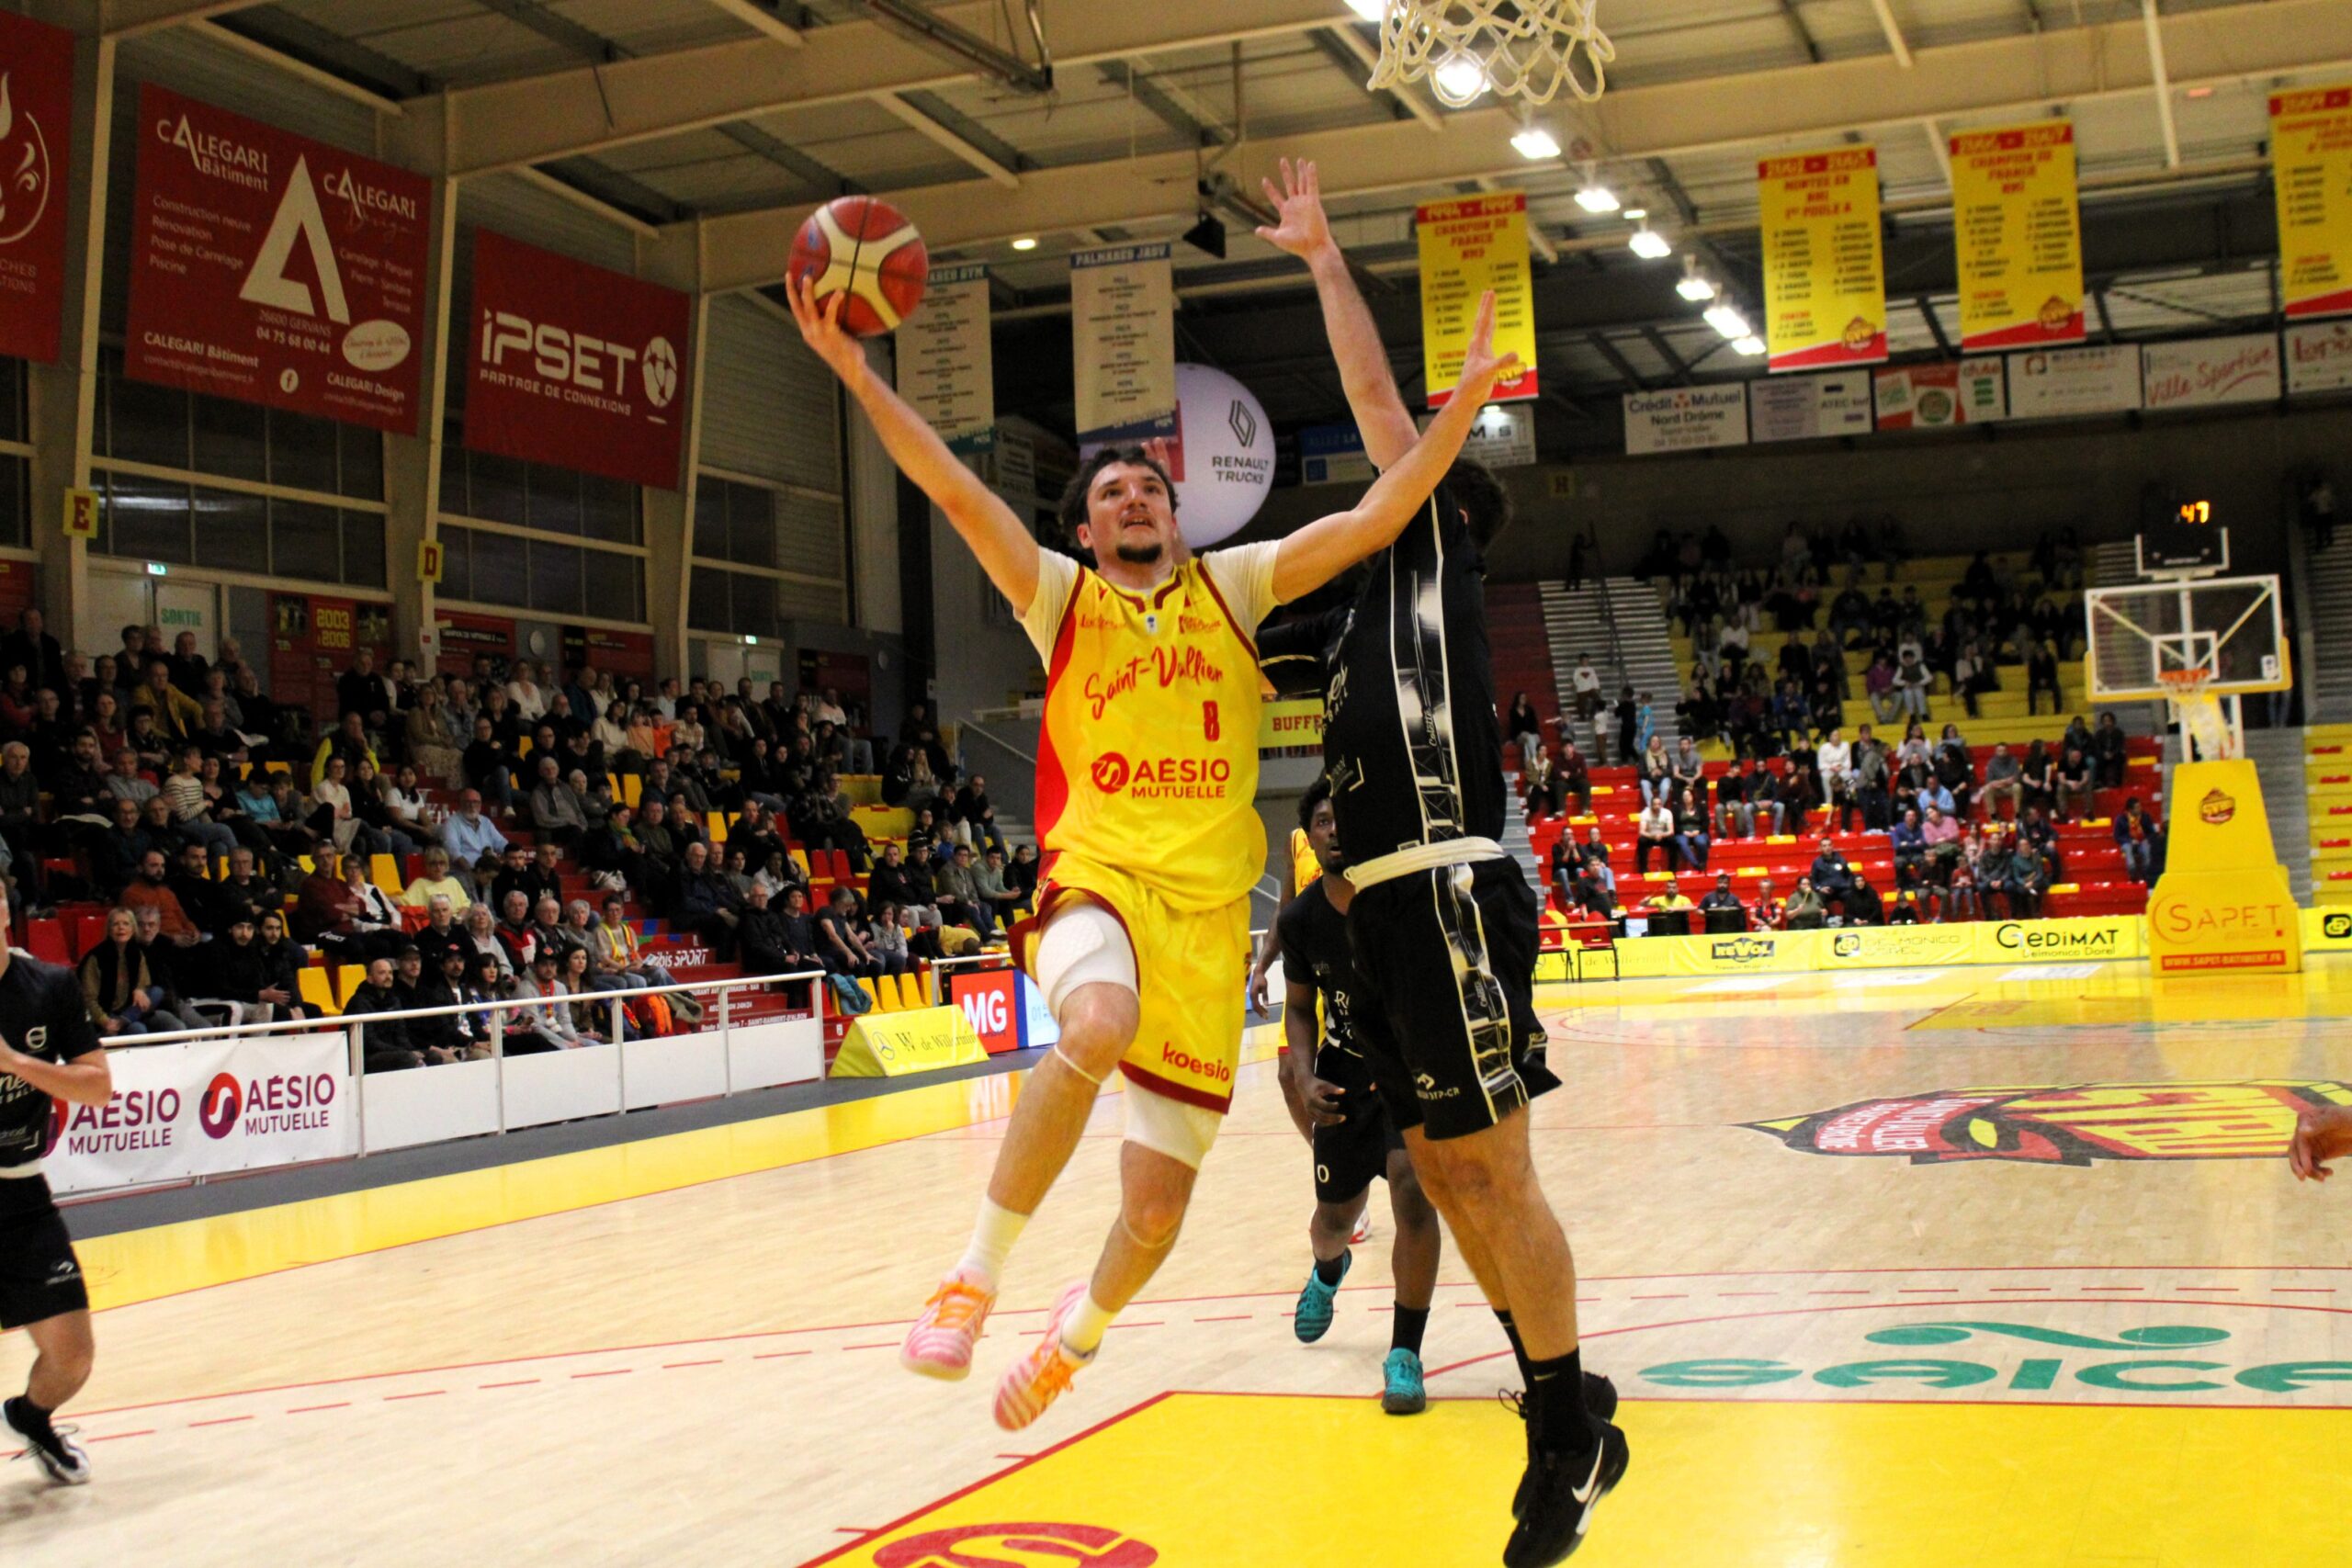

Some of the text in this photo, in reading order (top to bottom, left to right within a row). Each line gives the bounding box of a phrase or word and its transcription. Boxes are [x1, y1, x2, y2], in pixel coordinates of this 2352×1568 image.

[157, 113, 268, 174] CALEGARI
[323, 168, 415, 220] CALEGARI
[256, 325, 270, 340] 04
[274, 329, 286, 344] 75
[144, 332, 259, 368] CALEGARI Bâtiment
[326, 371, 373, 394] CALEGARI
[480, 368, 540, 394] PARTAGE
[545, 387, 560, 399] DE
[1691, 389, 1740, 405] Mutuel
[2148, 374, 2191, 404] Ville
[1650, 412, 1681, 425] Nord
[1212, 456, 1268, 469] RENAULT
[1216, 469, 1264, 484] TRUCKS
[73, 496, 90, 530] E
[2180, 501, 2210, 523] 47
[424, 547, 437, 576] D
[161, 608, 202, 626] SORTIE
[316, 608, 350, 629] 2003
[1084, 645, 1224, 720] Saint-Vallier
[1203, 700, 1220, 742] 8
[1133, 758, 1230, 783] AÉSIO
[1131, 785, 1226, 799] MUTUELLE
[964, 989, 1007, 1034] MG
[1162, 1041, 1230, 1082] koesio
[245, 1073, 335, 1113] AÉSIO
[70, 1088, 180, 1131] AÉSIO
[244, 1110, 329, 1136] MUTUELLE
[68, 1127, 172, 1156] MUTUELLE
